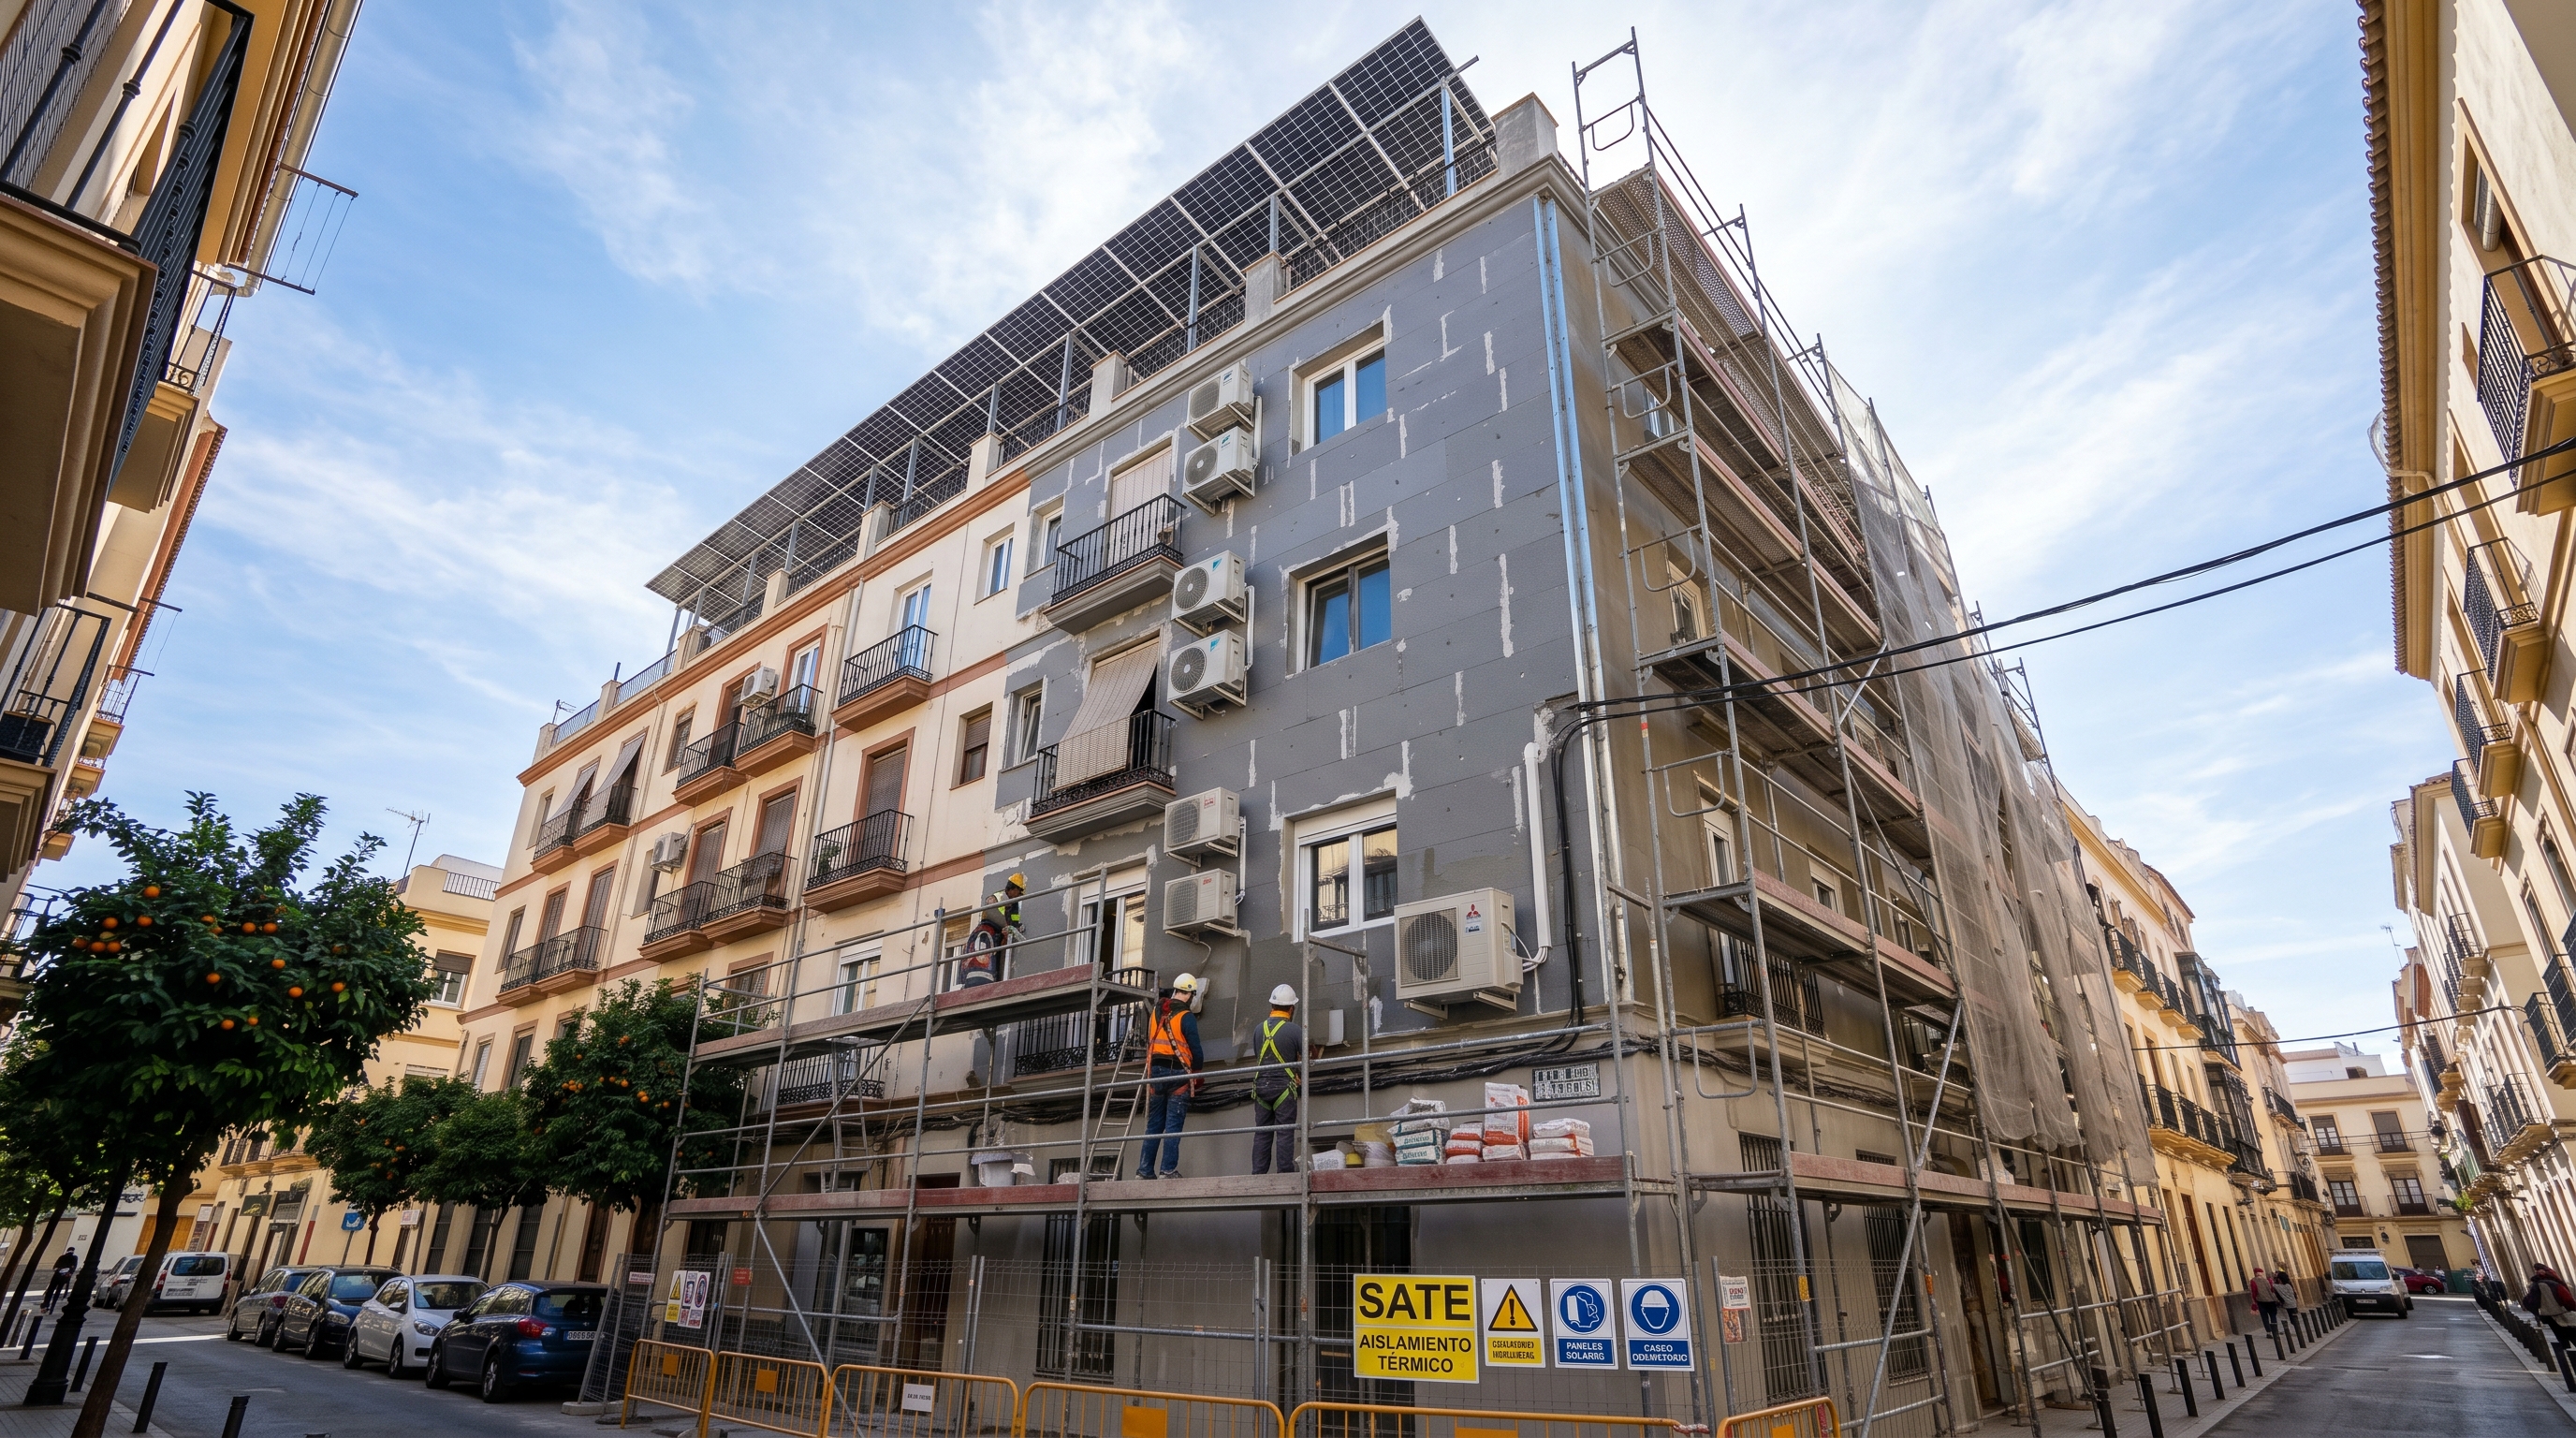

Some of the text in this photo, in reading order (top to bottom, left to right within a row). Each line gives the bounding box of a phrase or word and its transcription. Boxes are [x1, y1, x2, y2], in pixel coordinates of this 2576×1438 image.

[1359, 1283, 1471, 1321] SATE
[1359, 1334, 1471, 1353] AISLAMIENTO
[1566, 1342, 1603, 1351] PANELES
[1644, 1343, 1674, 1353] CASEO
[1378, 1352, 1454, 1373] TÉRMICO
